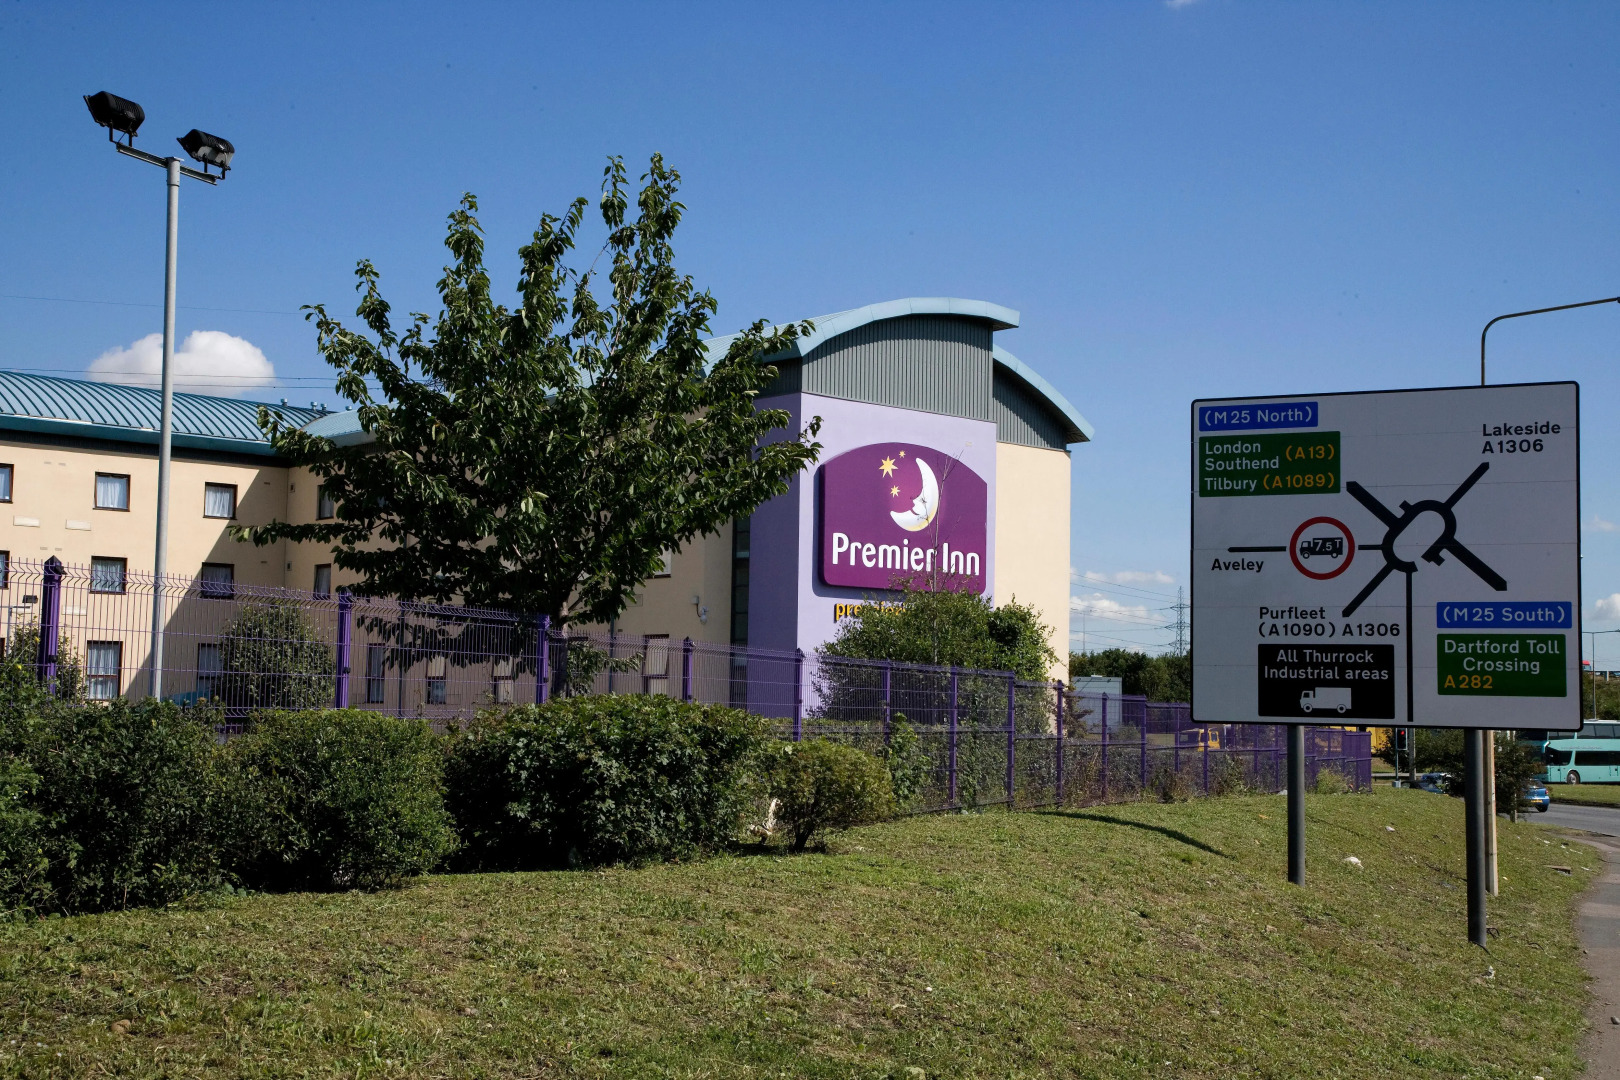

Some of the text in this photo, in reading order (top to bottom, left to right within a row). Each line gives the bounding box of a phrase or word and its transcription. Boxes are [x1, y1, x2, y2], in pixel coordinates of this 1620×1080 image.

[1257, 406, 1312, 423] North)
[1482, 421, 1561, 437] Lakeside
[1205, 441, 1261, 455] London
[1285, 443, 1335, 461] (A13)
[1482, 439, 1544, 454] A1306
[1205, 456, 1280, 471] Southend
[1204, 472, 1335, 492] Tilbury (A1089)
[832, 532, 980, 576] Premier Inn
[1211, 558, 1264, 573] Aveley
[1259, 606, 1326, 620] Purfleet
[1501, 605, 1565, 623] South)
[1258, 622, 1400, 638] (A1090) A1306
[1444, 639, 1560, 654] Dartford Toll
[1277, 649, 1374, 663] All Thurrock
[1264, 665, 1389, 680] Industrial areas
[1463, 657, 1541, 675] Crossing
